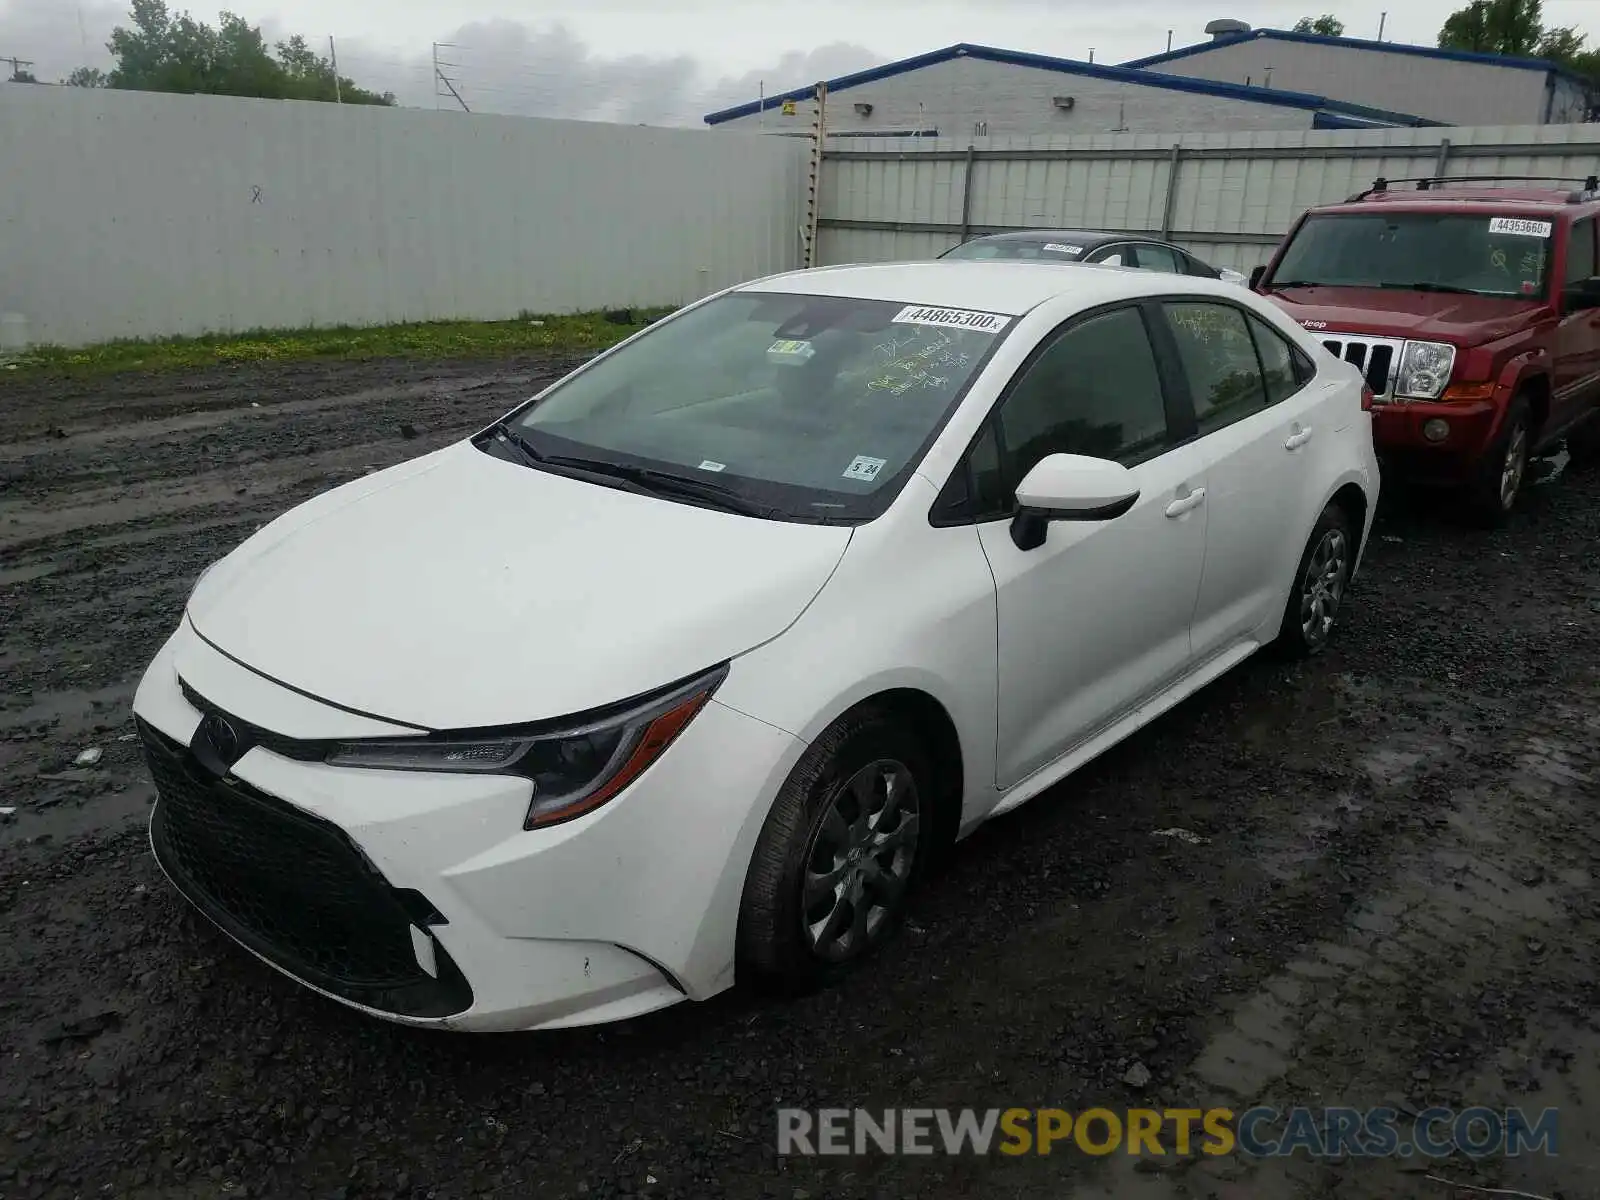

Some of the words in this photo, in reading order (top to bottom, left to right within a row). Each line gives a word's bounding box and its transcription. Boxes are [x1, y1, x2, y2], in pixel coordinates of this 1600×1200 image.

[1497, 219, 1543, 234] 44353660
[910, 308, 995, 328] 44865300
[1301, 319, 1327, 329] Jeep
